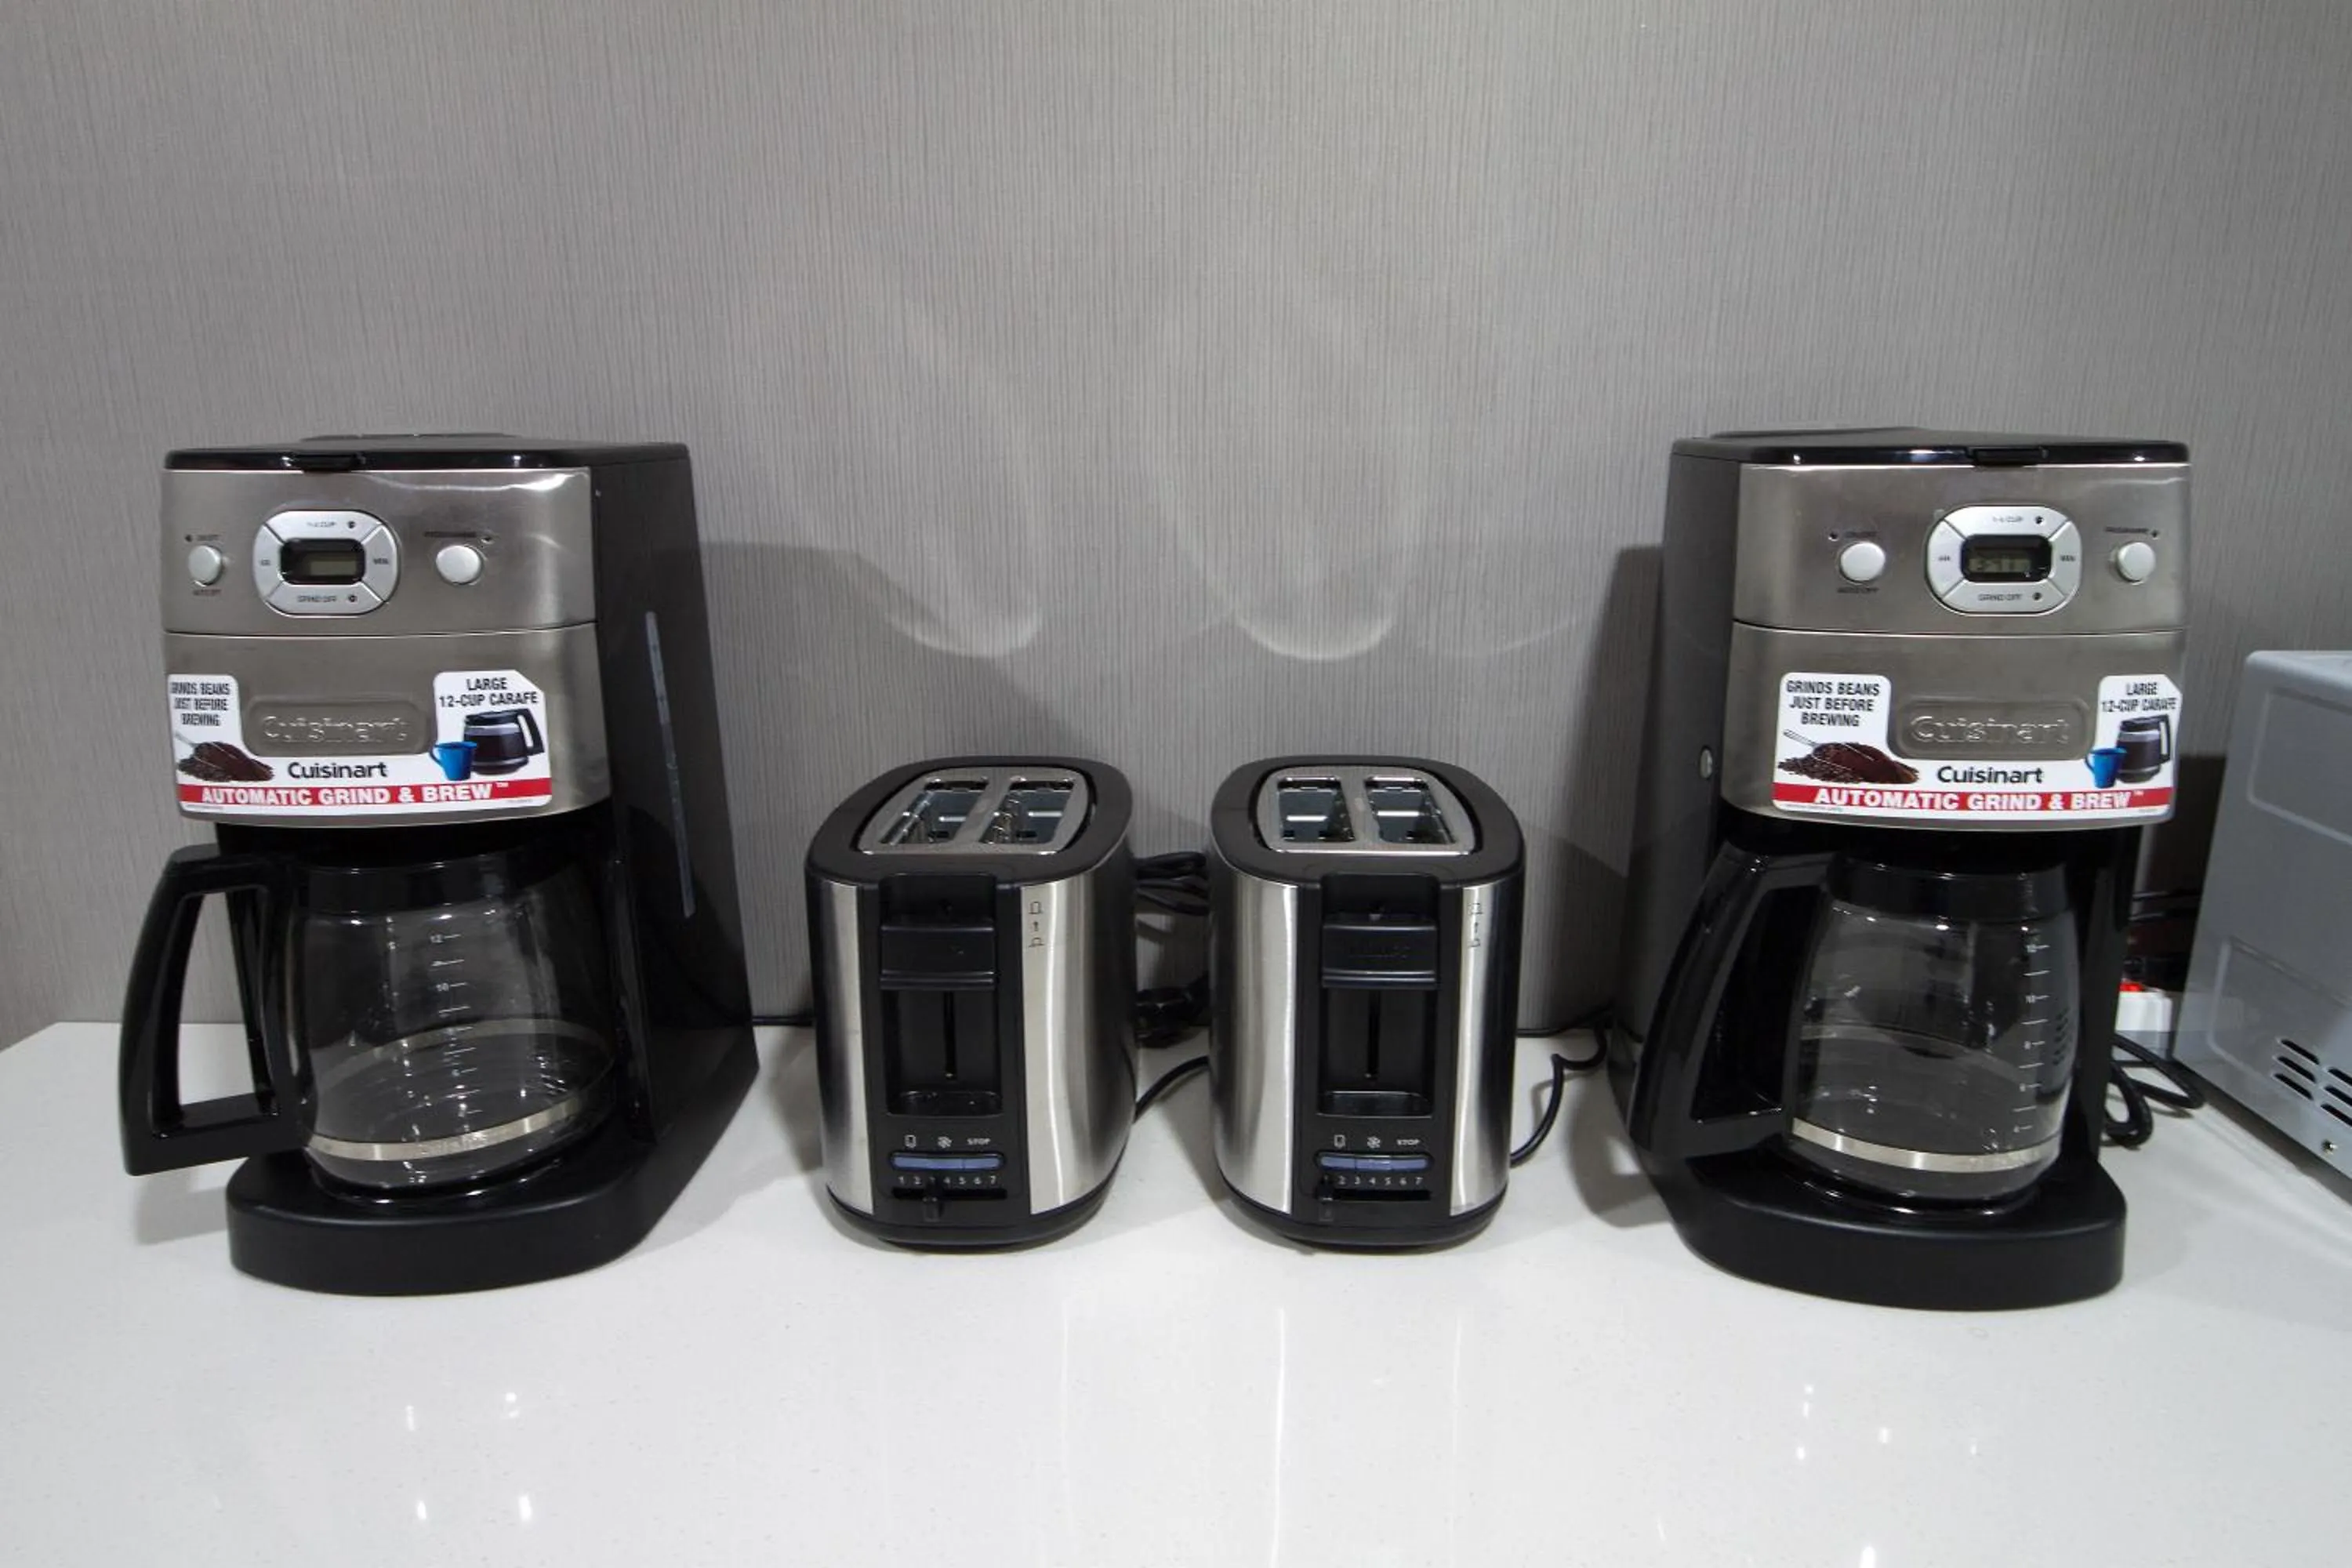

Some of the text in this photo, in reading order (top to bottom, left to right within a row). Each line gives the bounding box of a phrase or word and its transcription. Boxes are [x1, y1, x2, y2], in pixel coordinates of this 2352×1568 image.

[466, 677, 507, 691] LARGE
[1786, 681, 1880, 696] GRINDS BEANS
[2125, 682, 2158, 695] LARGE
[439, 691, 538, 707] 12-CUP CARAFE
[1789, 696, 1875, 712] JUST BEFORE
[1801, 712, 1860, 727] BREWING
[288, 762, 387, 779] Cuisinart
[1936, 766, 2044, 784] Cuisinart
[201, 787, 313, 805] AUTOMATIC
[318, 788, 390, 804] GRIND
[397, 786, 415, 803] &
[422, 783, 492, 802] BREW
[1815, 787, 2132, 810] AUTOMATIC GRIND & BREW
[990, 1175, 997, 1185] 7
[1338, 1176, 1346, 1185] 2
[1415, 1177, 1424, 1185] 7
